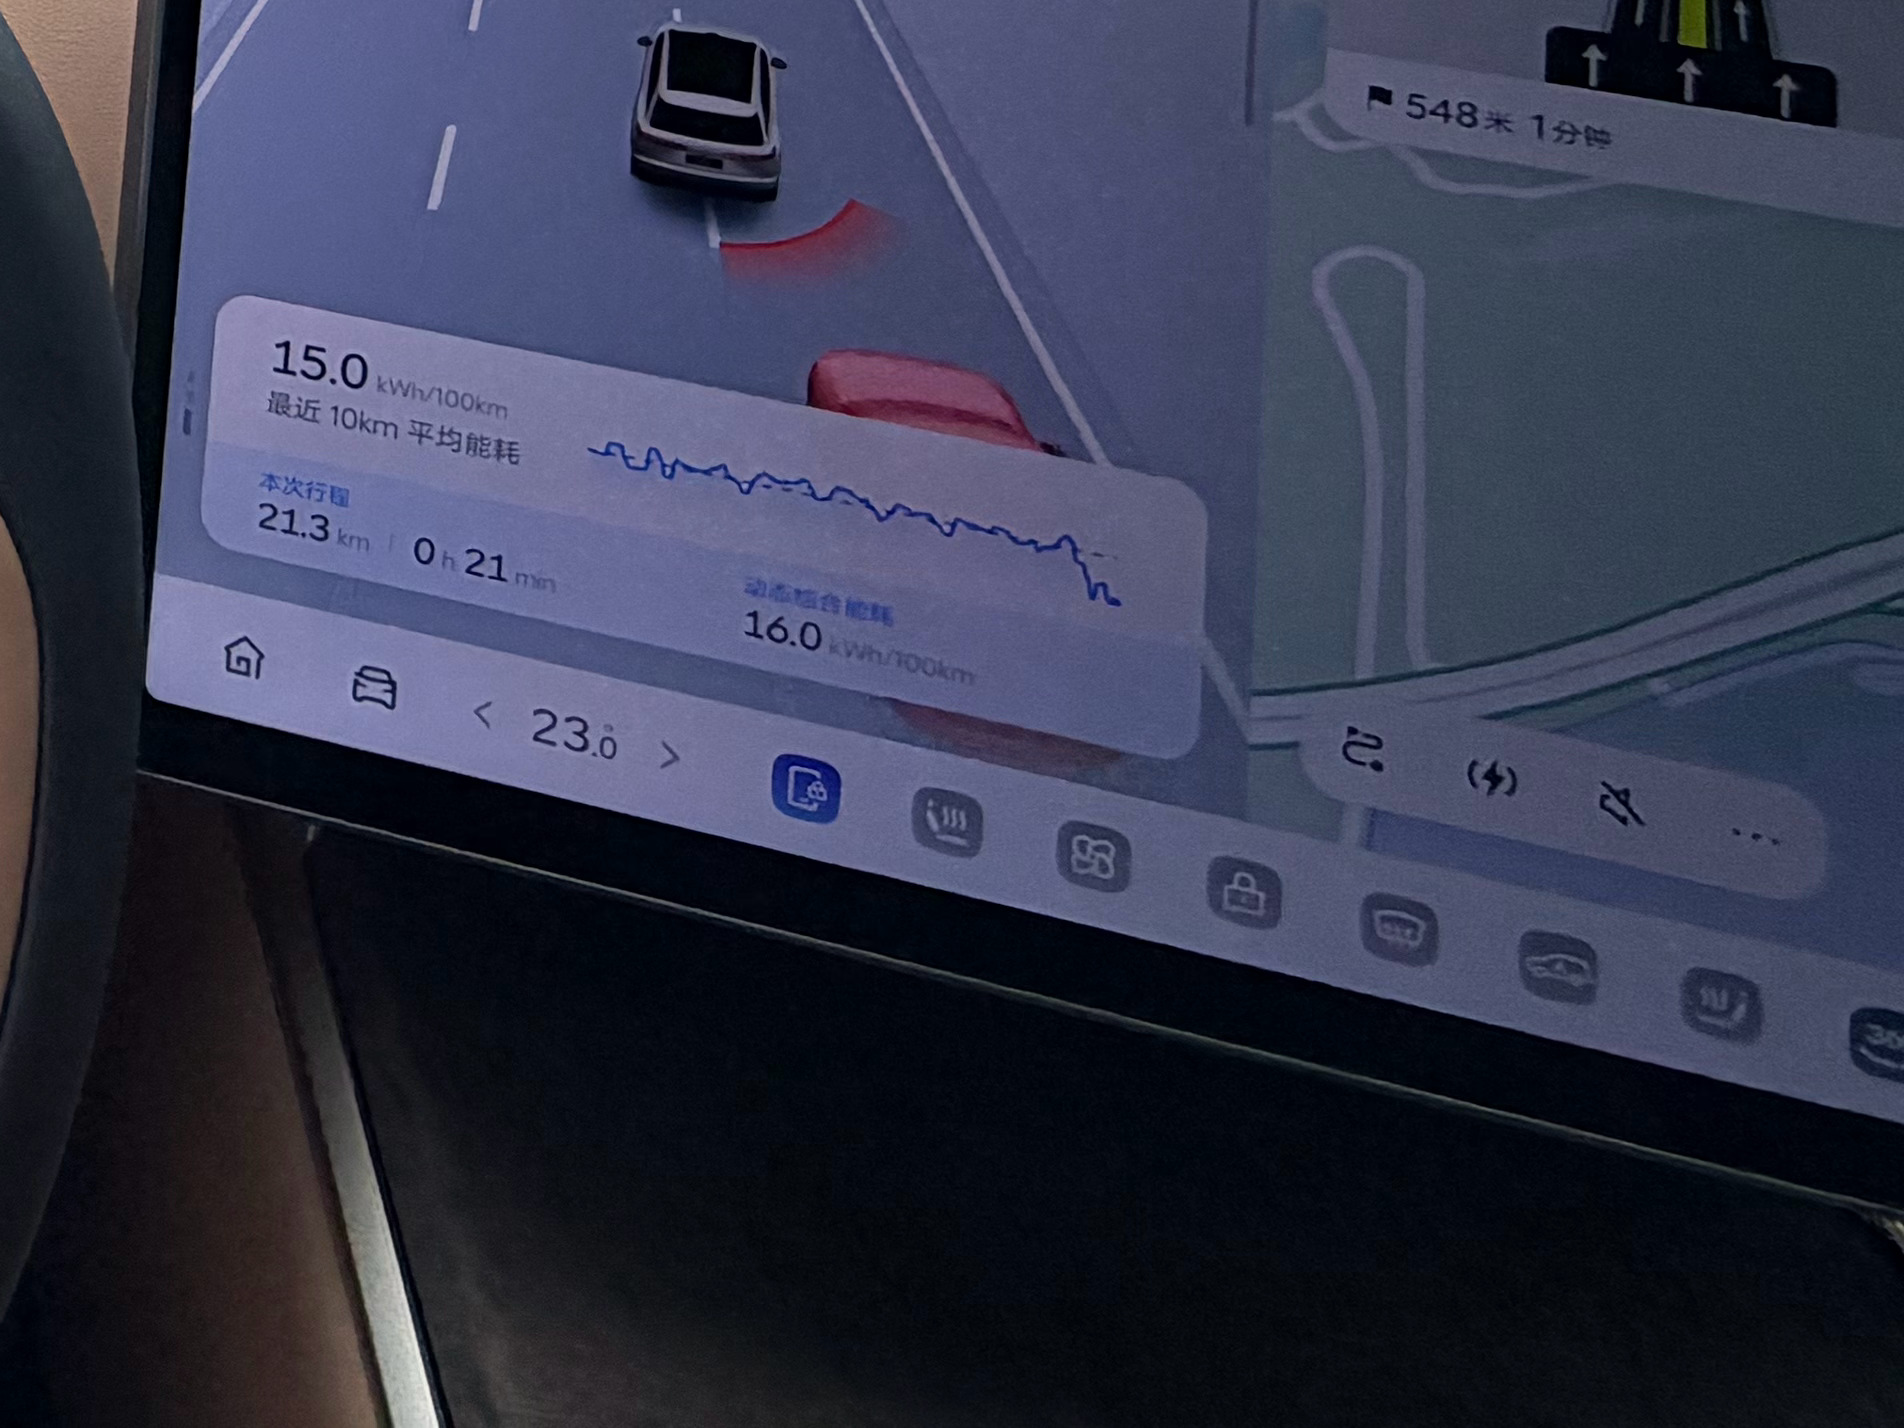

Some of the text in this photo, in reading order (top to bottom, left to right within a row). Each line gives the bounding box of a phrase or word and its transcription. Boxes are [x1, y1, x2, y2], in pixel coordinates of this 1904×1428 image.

[272, 340, 508, 421] 15.0 kWh/100km
[266, 390, 521, 466] 最近 10km 平均能耗
[257, 502, 330, 542] 21.3
[336, 528, 371, 553] km
[413, 536, 436, 566] 0
[442, 550, 456, 573] h
[464, 547, 509, 582] 21
[743, 609, 977, 687] 16.0 kWh/100km
